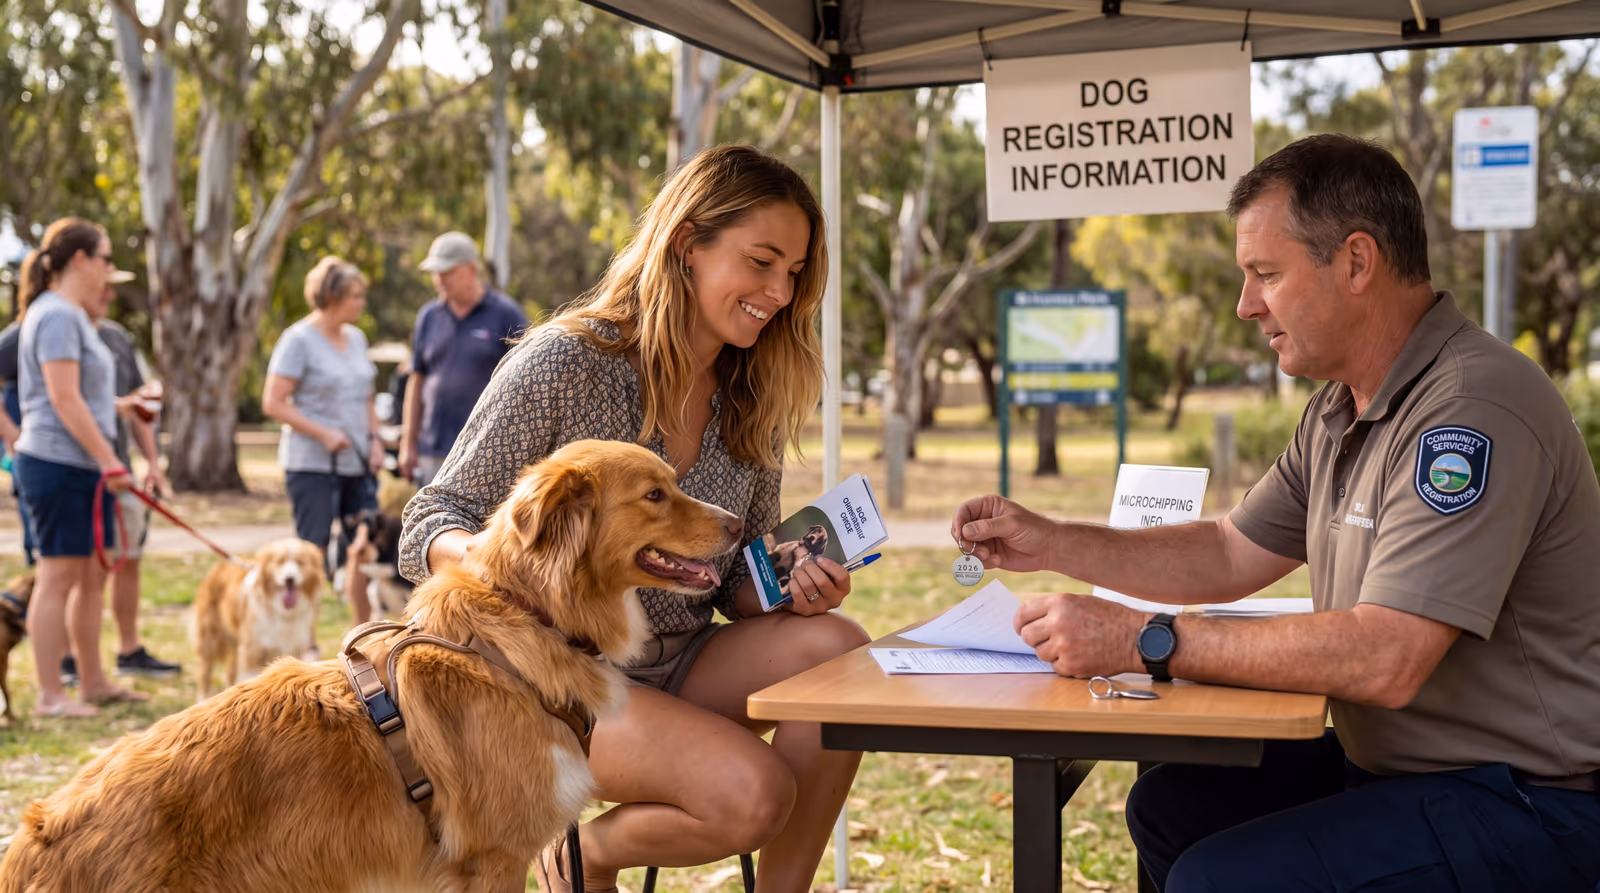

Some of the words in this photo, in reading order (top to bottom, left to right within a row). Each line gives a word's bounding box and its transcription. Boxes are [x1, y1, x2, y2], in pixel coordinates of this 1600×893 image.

[1081, 78, 1149, 107] DOG
[1003, 113, 1233, 152] REGISTRATION
[1012, 154, 1226, 191] INFORMATION
[1427, 433, 1483, 448] COMMUNITY
[1432, 442, 1475, 455] SERVICES
[1421, 483, 1477, 503] REGISTRATION
[1119, 495, 1193, 511] MICROCHIPPING
[1140, 515, 1163, 527] INFO
[957, 564, 979, 572] 2026
